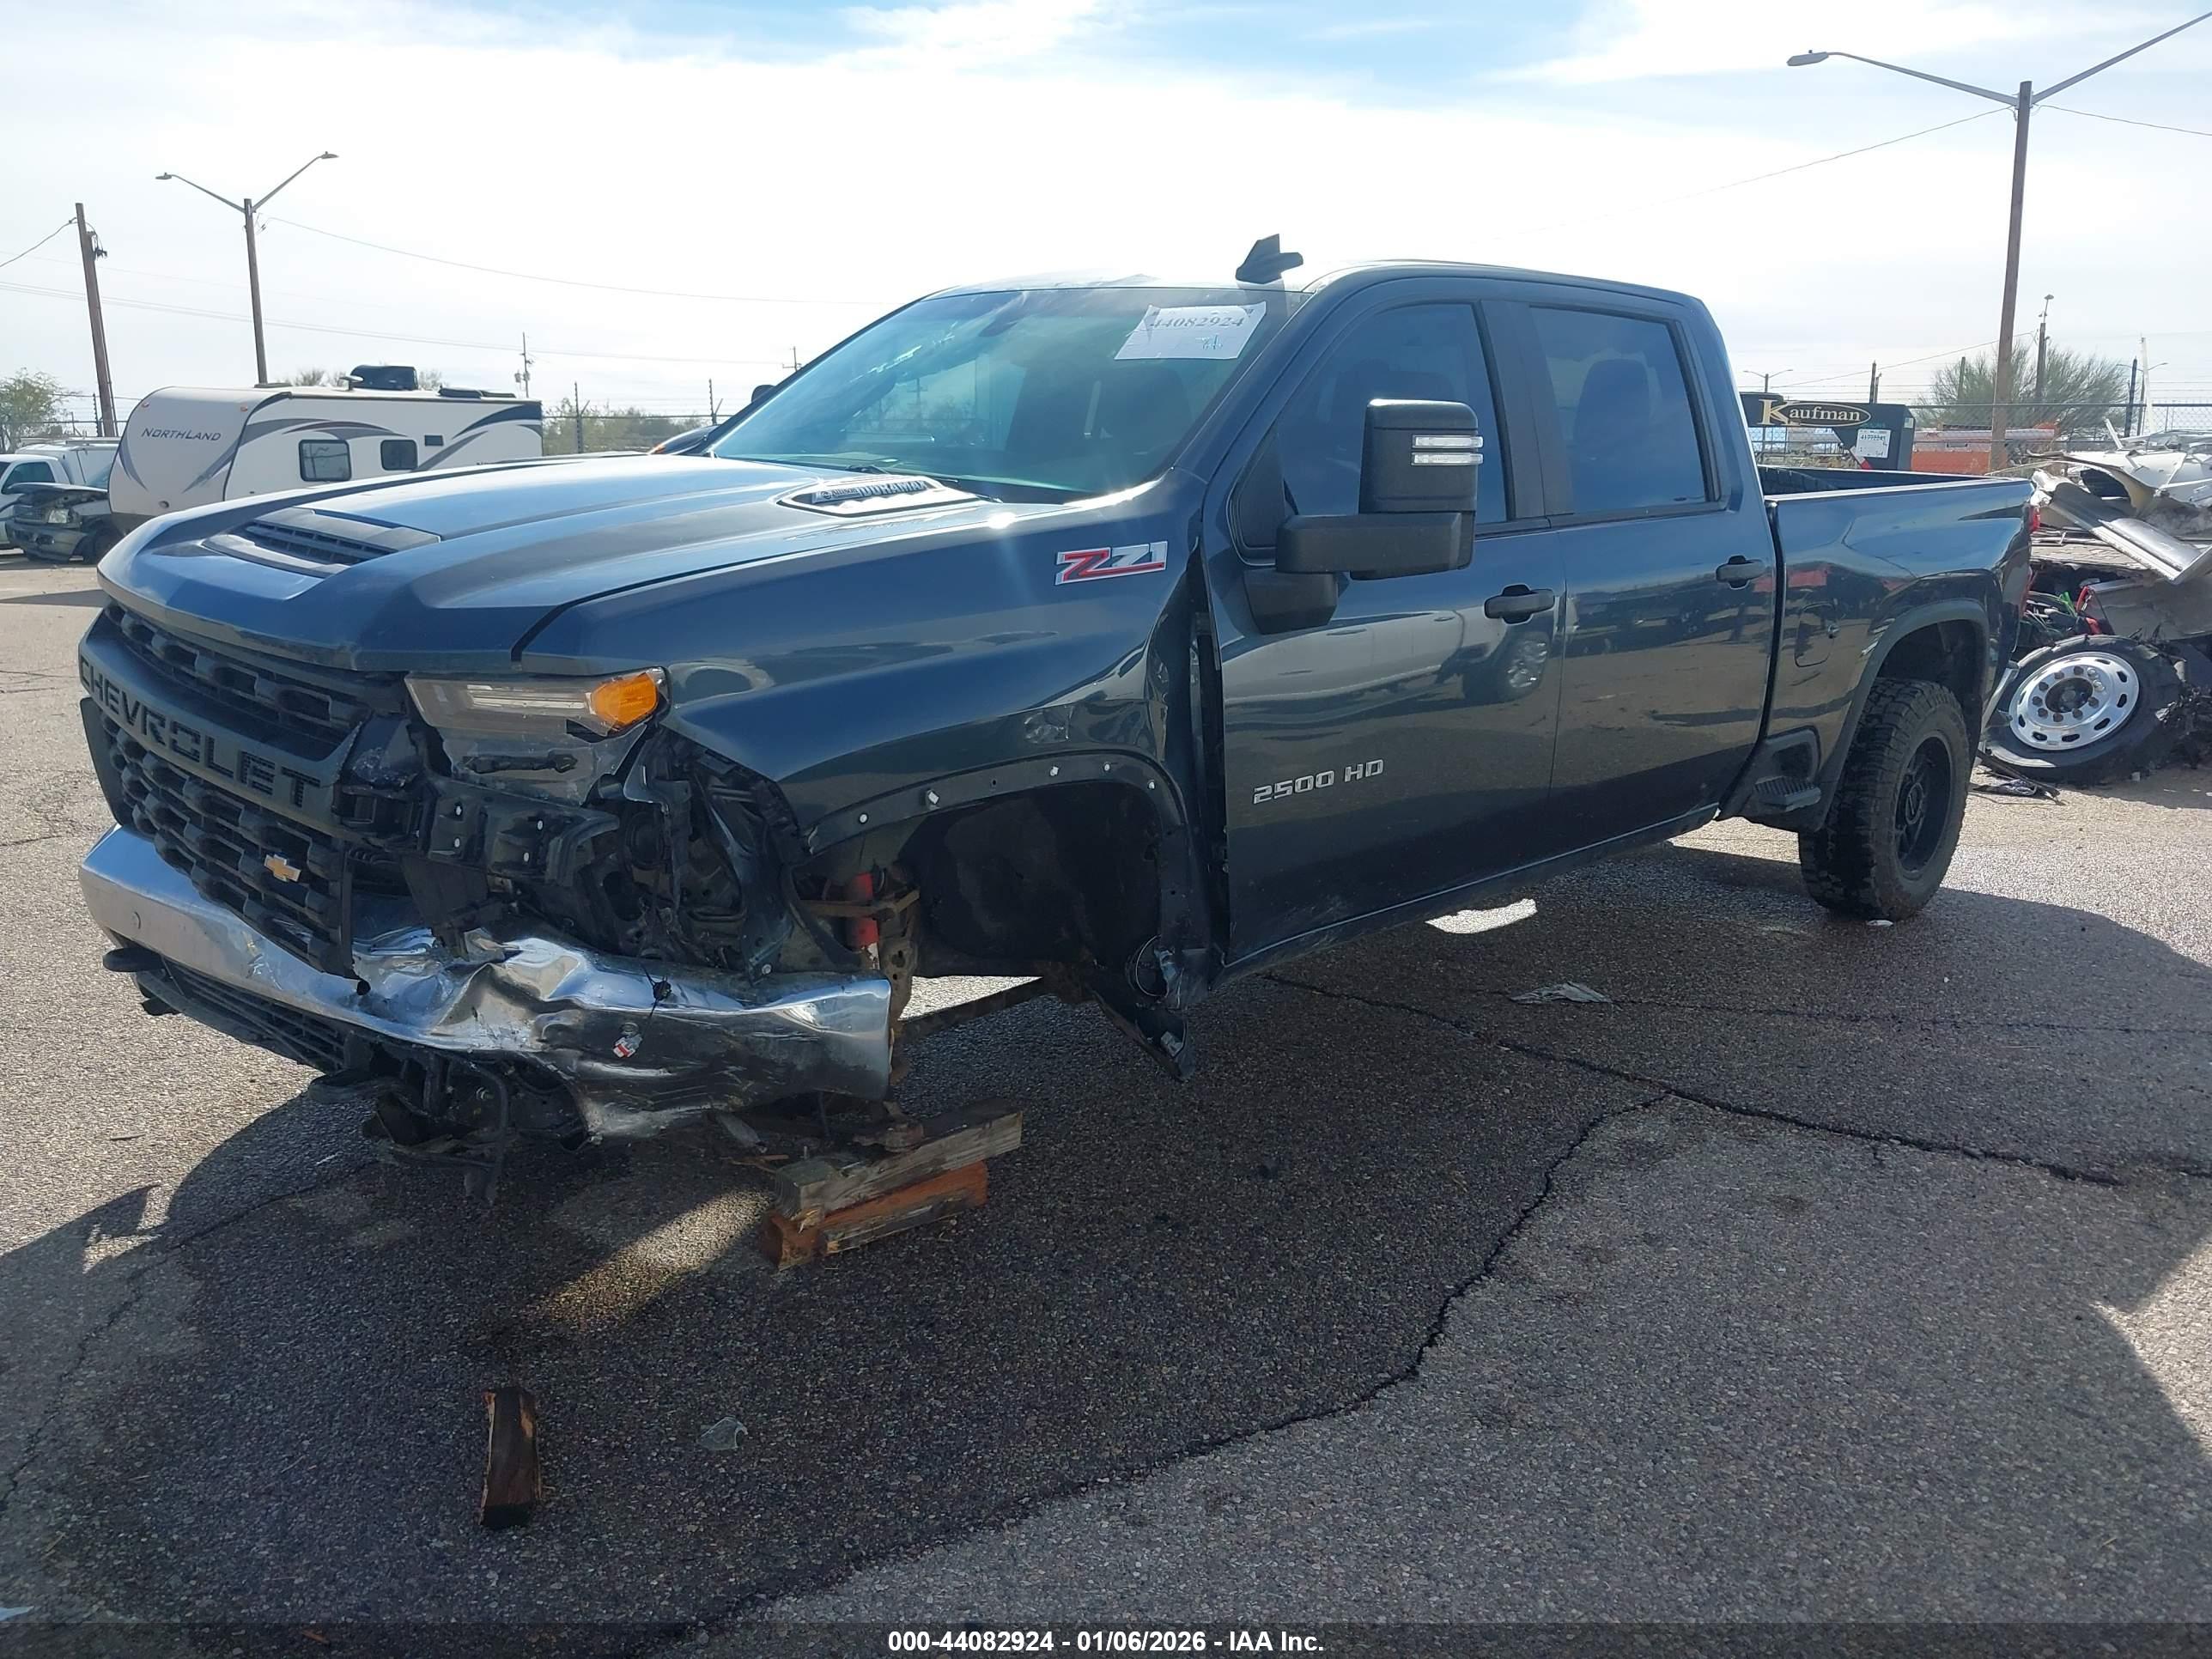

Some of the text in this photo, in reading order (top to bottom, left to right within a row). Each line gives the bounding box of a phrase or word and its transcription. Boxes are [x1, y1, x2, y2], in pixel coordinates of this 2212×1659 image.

[1758, 398, 1861, 426] Kaufman
[860, 480, 928, 497] DURAMAX
[1055, 541, 1168, 586] Z71
[81, 653, 321, 808] CHEVROLET
[1253, 759, 1384, 805] 2500 HD
